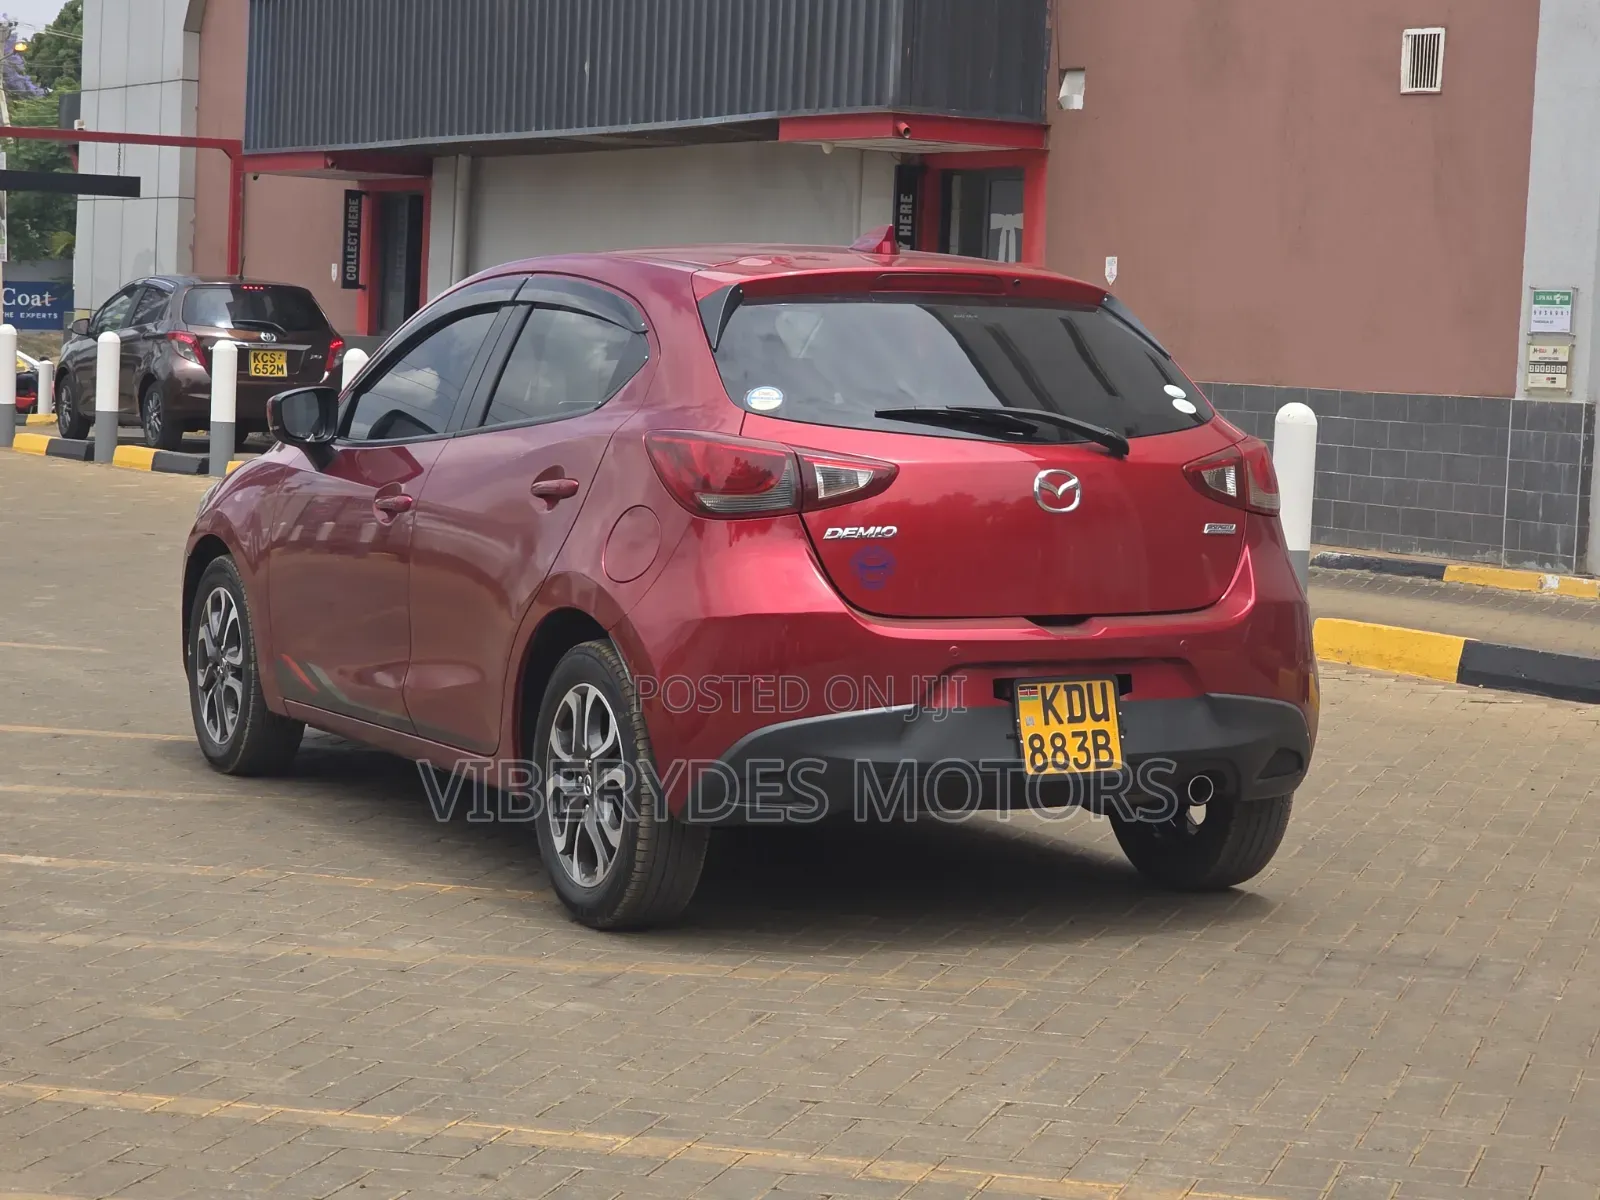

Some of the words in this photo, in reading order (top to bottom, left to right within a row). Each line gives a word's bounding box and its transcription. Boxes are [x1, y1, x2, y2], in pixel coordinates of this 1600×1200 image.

[348, 198, 359, 228] HERE
[899, 193, 913, 236] HERE
[346, 231, 358, 280] COLLECT
[2, 287, 52, 307] Coat
[253, 353, 276, 363] KCS
[253, 364, 285, 375] 652M
[823, 526, 898, 540] DEMIO
[1040, 682, 1110, 726] KDU
[1028, 729, 1115, 773] 883B
